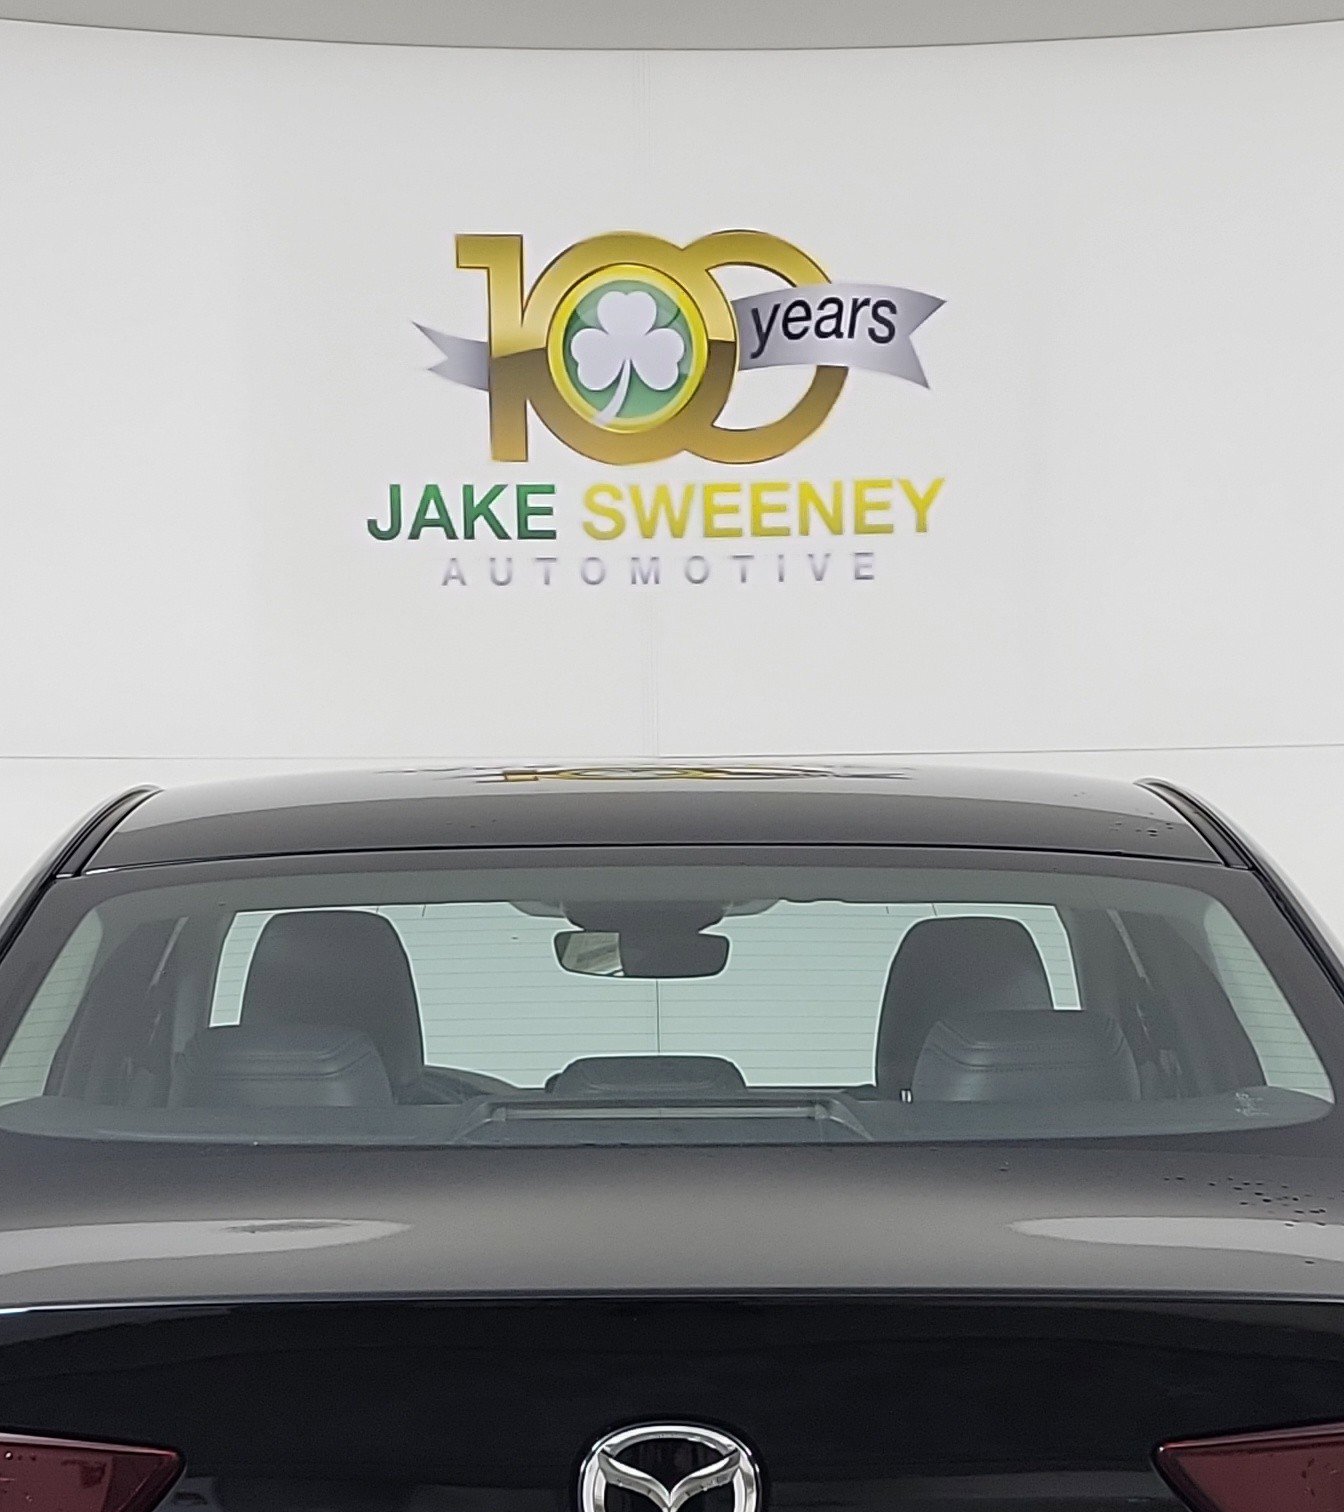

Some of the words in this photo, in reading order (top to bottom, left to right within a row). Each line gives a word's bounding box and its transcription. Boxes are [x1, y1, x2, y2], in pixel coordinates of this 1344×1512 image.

[749, 296, 898, 358] years
[367, 483, 558, 540] JAKE
[582, 478, 945, 540] SWEENEY
[442, 552, 876, 586] AUTOMOTIVE
